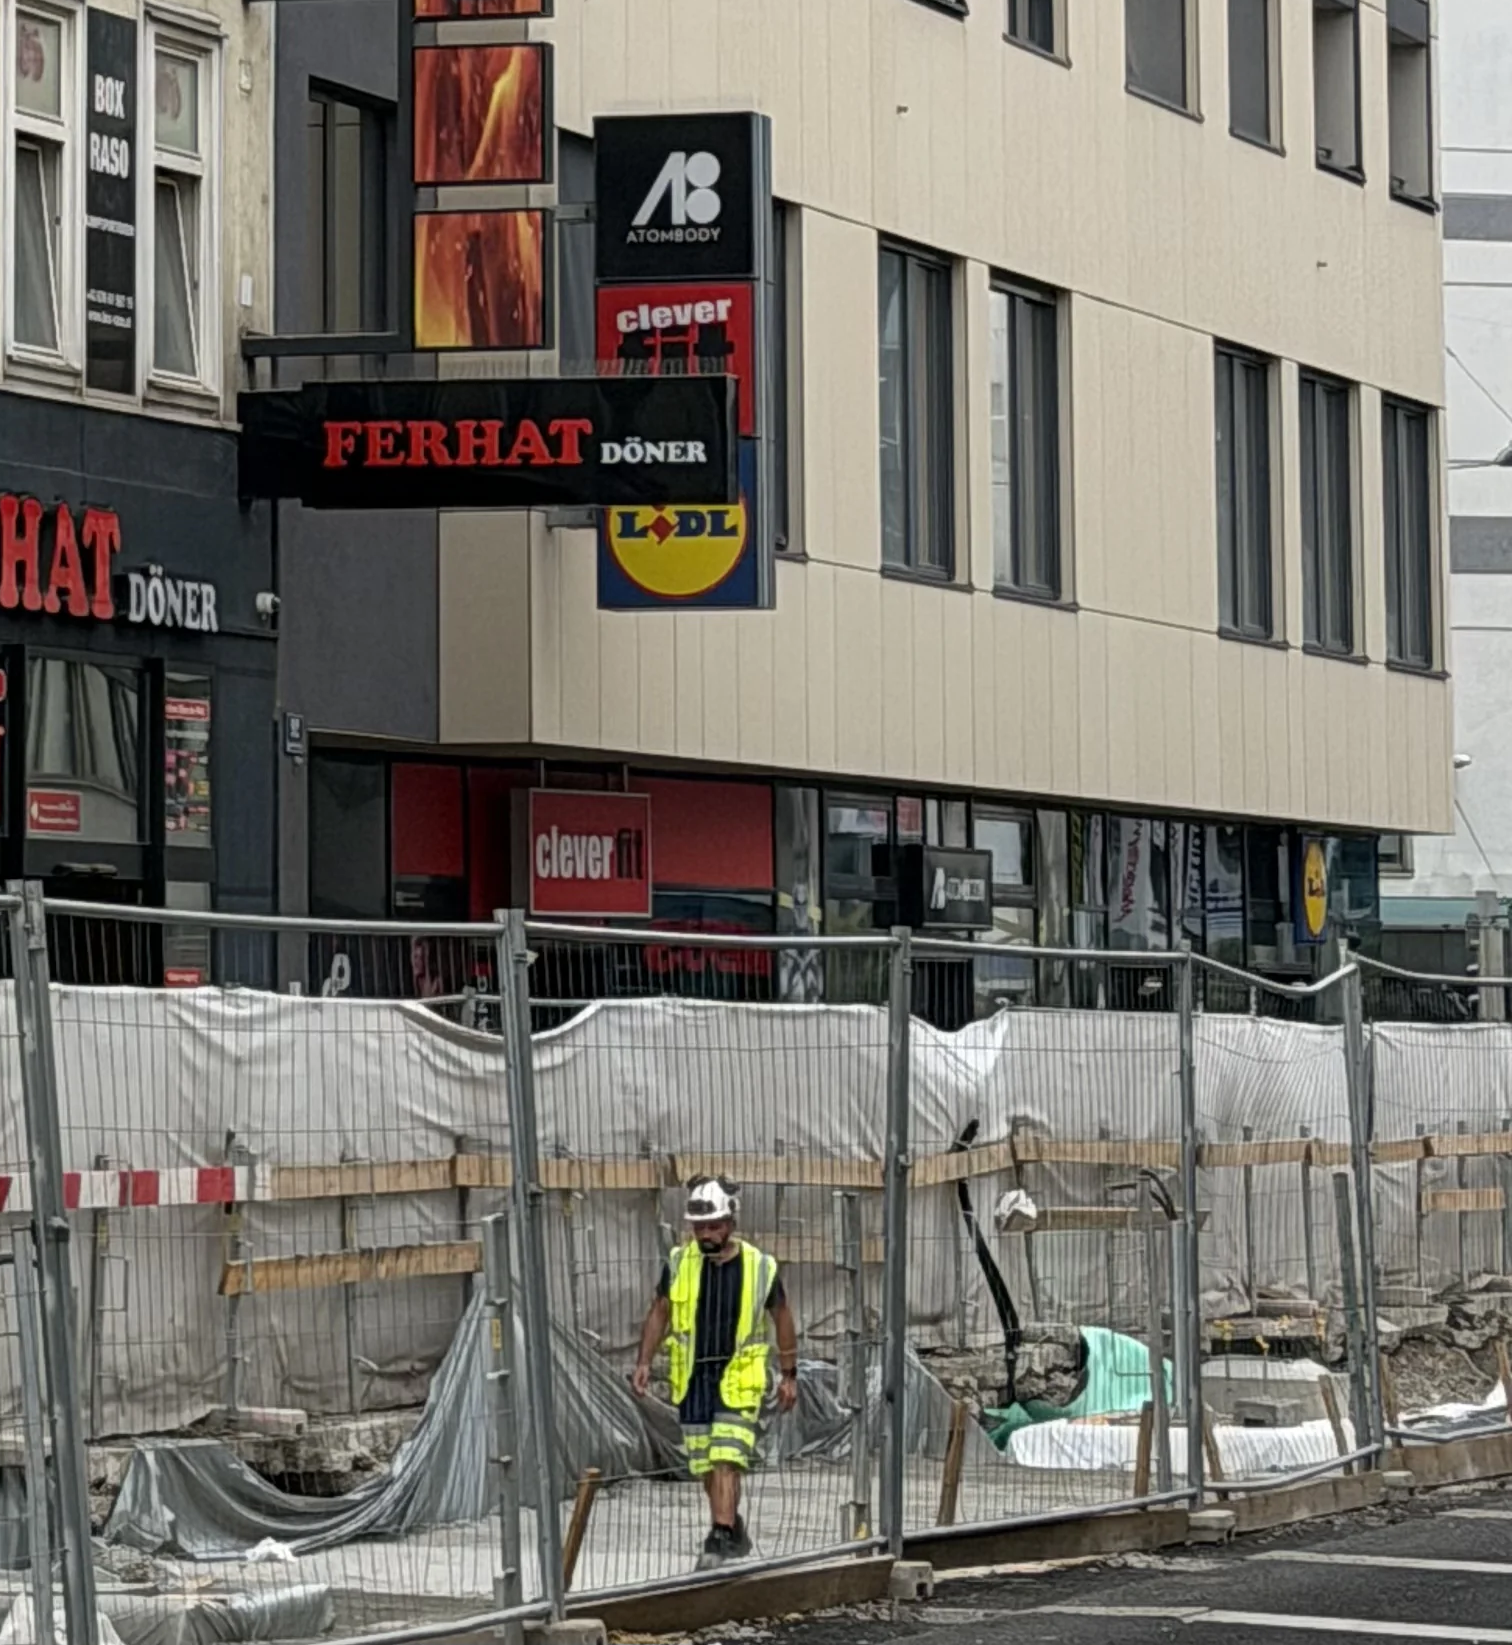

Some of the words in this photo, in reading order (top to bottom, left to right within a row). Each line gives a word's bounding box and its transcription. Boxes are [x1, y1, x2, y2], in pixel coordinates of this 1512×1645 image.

[94, 73, 126, 120] BOX
[89, 131, 130, 180] RASO
[626, 227, 721, 244] ATOMBODY
[616, 298, 732, 334] clever
[322, 418, 593, 468] FERHAT
[600, 436, 707, 464] DÖNER
[127, 563, 219, 633] DÖNER
